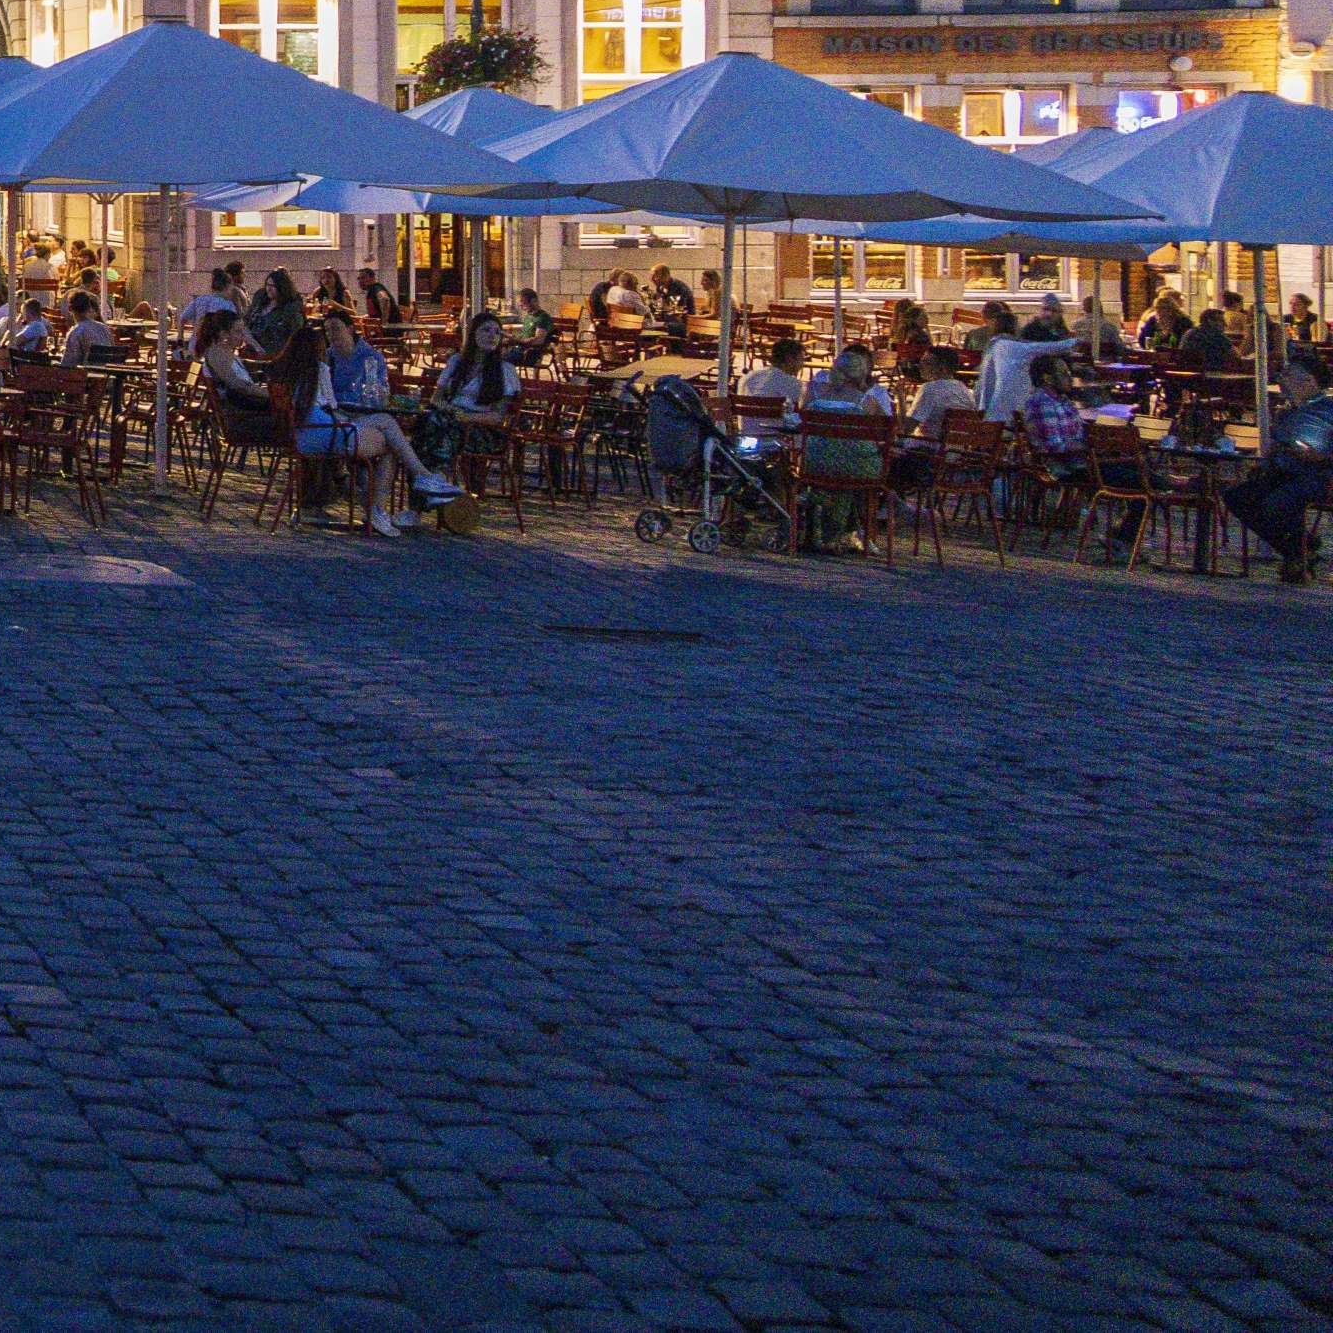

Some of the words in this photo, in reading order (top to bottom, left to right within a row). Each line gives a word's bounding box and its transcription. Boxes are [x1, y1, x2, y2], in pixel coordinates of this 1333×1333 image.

[823, 34, 941, 54] MAISON
[955, 33, 1019, 54] DES
[1031, 31, 1223, 53] BRASSEURS
